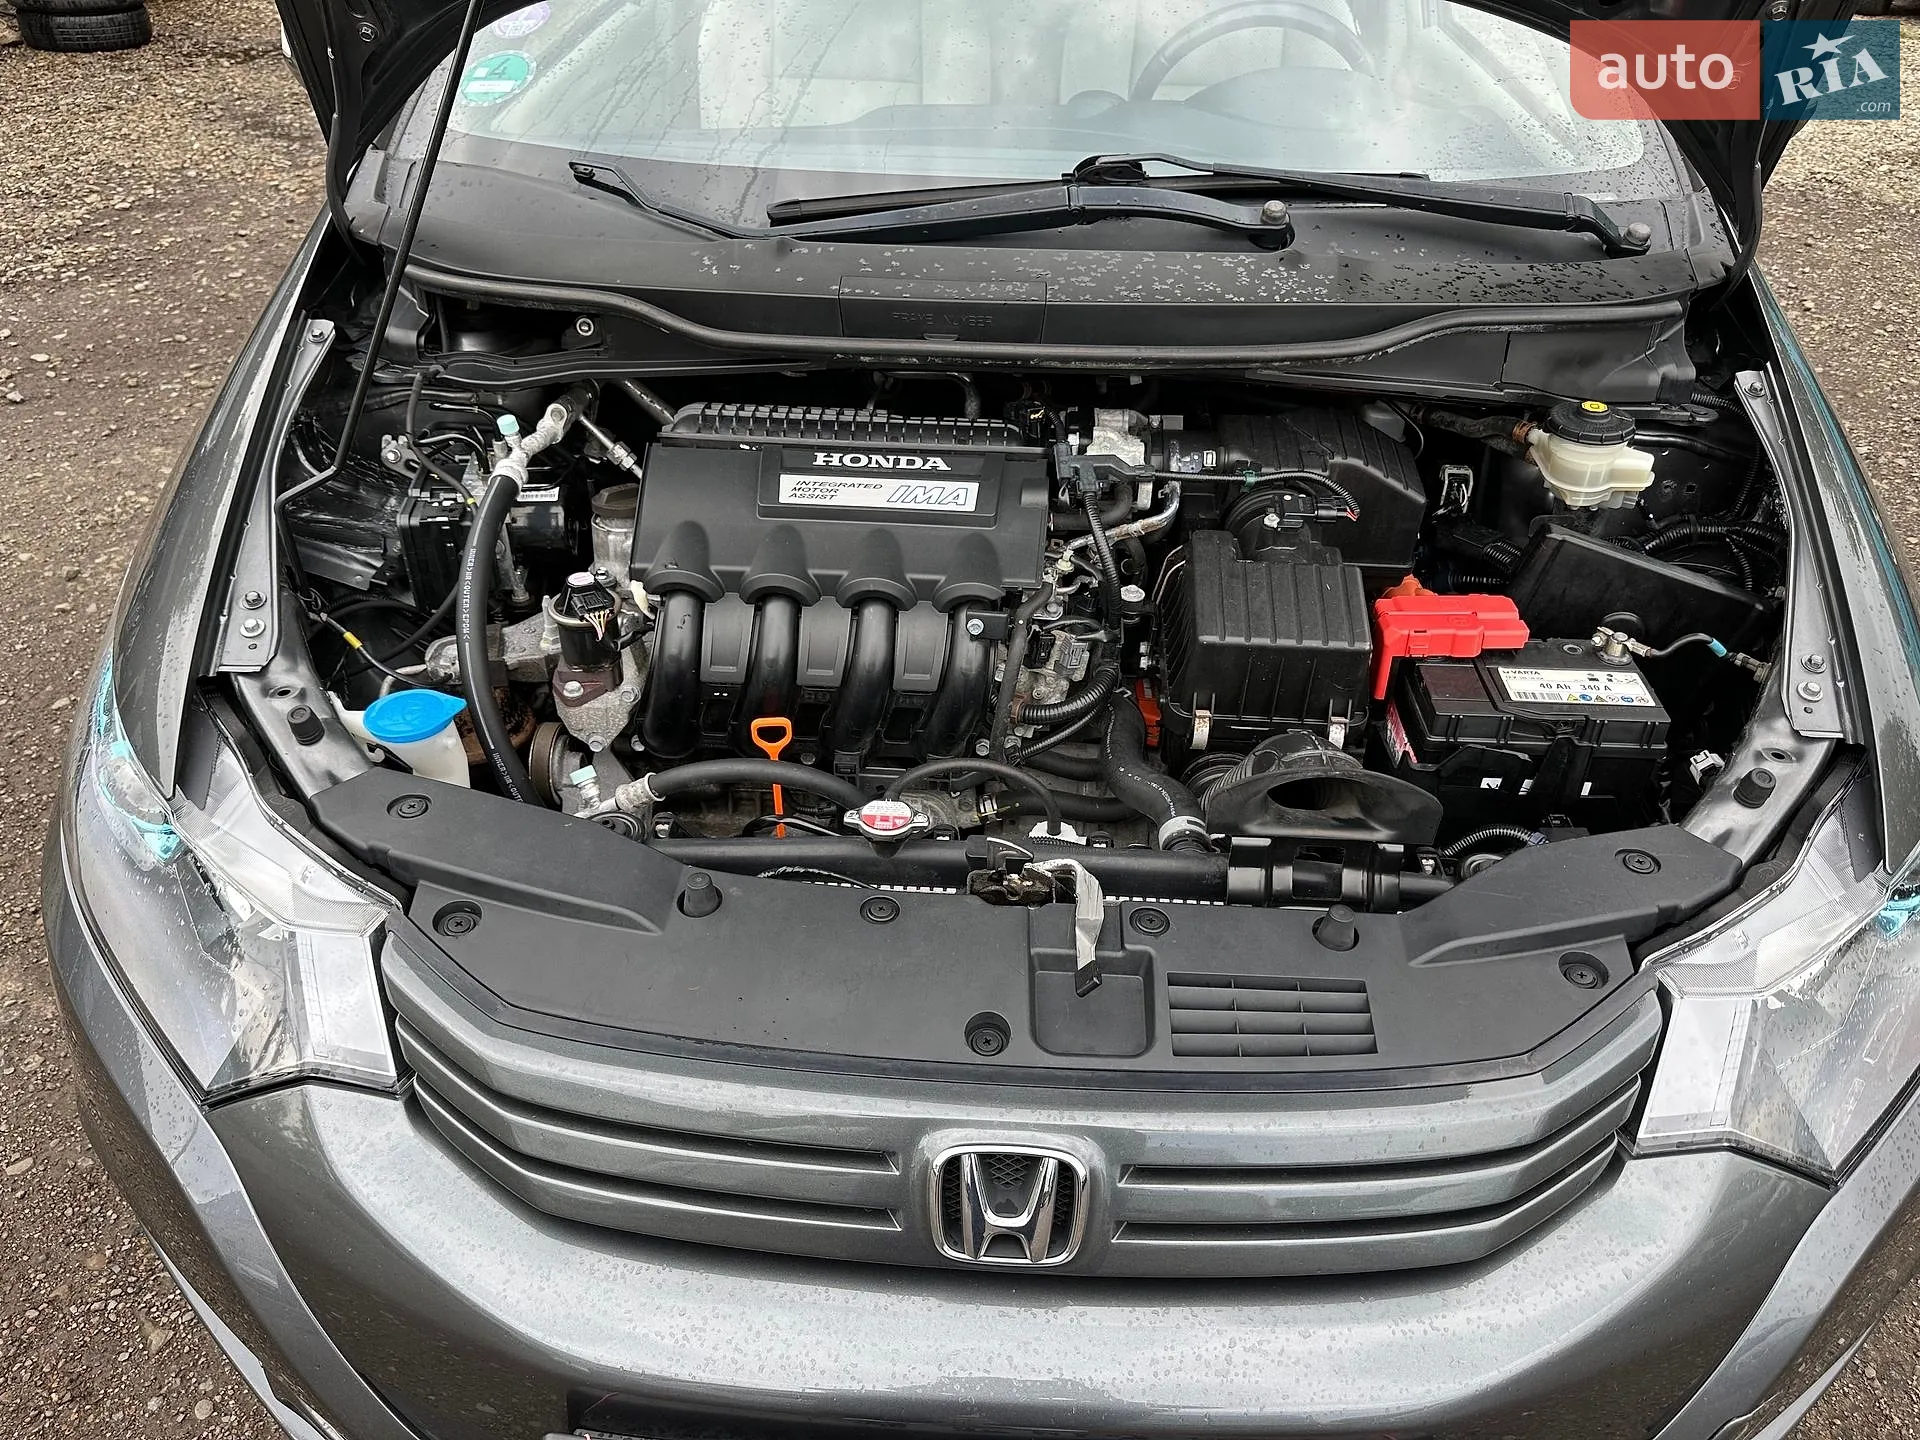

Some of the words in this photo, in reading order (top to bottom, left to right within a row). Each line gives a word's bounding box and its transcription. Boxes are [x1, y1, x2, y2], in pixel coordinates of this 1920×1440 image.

[813, 452, 951, 470] HONDA
[796, 480, 883, 490] INTEGRATED
[887, 484, 969, 506] IMA
